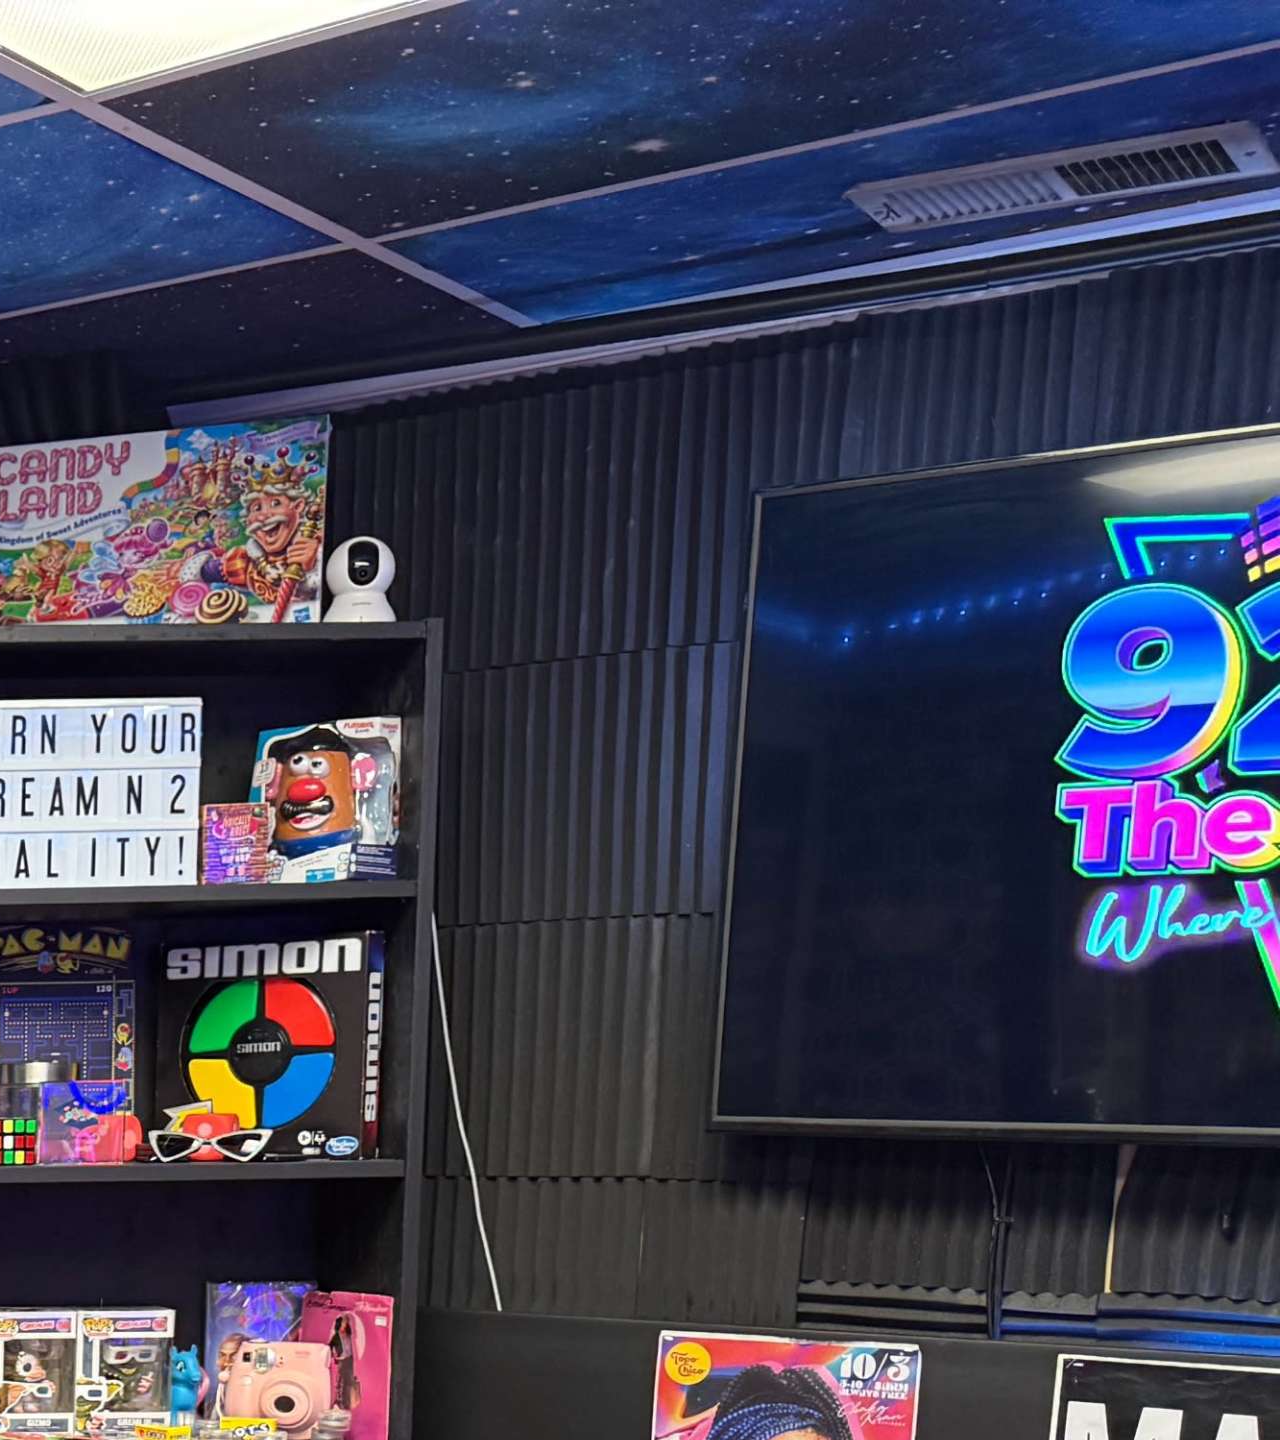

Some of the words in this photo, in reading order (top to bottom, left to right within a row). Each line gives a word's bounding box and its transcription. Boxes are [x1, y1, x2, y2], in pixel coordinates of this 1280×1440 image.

[90, 712, 196, 754] YOUR
[126, 774, 143, 815] N
[169, 773, 187, 814] 2
[1055, 777, 1278, 878] The
[1085, 882, 1276, 962] Where
[166, 937, 362, 981] simon
[237, 1041, 281, 1054] simon
[840, 1352, 911, 1382] 10/3
